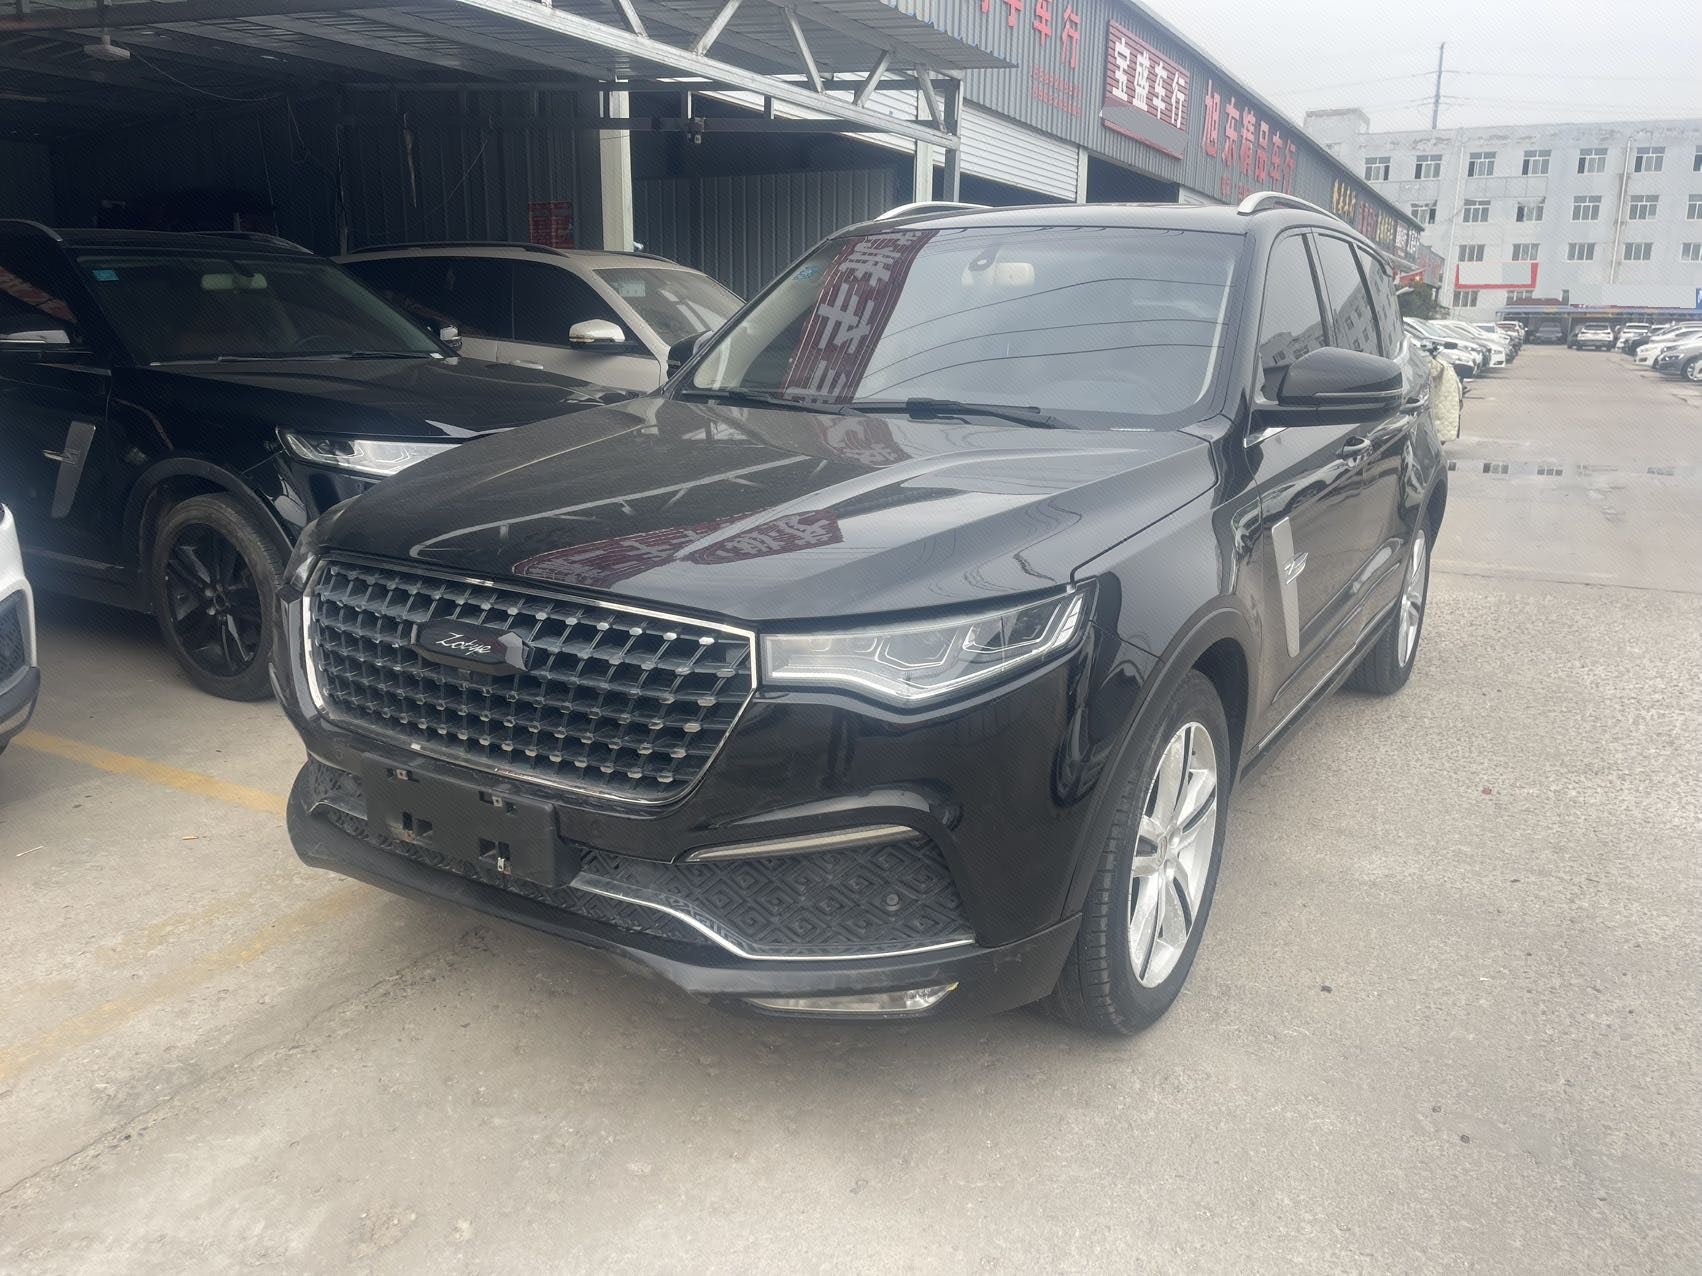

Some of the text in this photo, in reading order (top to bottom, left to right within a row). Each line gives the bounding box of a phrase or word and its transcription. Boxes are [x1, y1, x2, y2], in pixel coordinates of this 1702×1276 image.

[981, 0, 1081, 69] 车行
[1112, 38, 1186, 129] 宝盛车行
[1201, 79, 1297, 196] 旭东精品车行
[435, 632, 492, 656] Zotye
